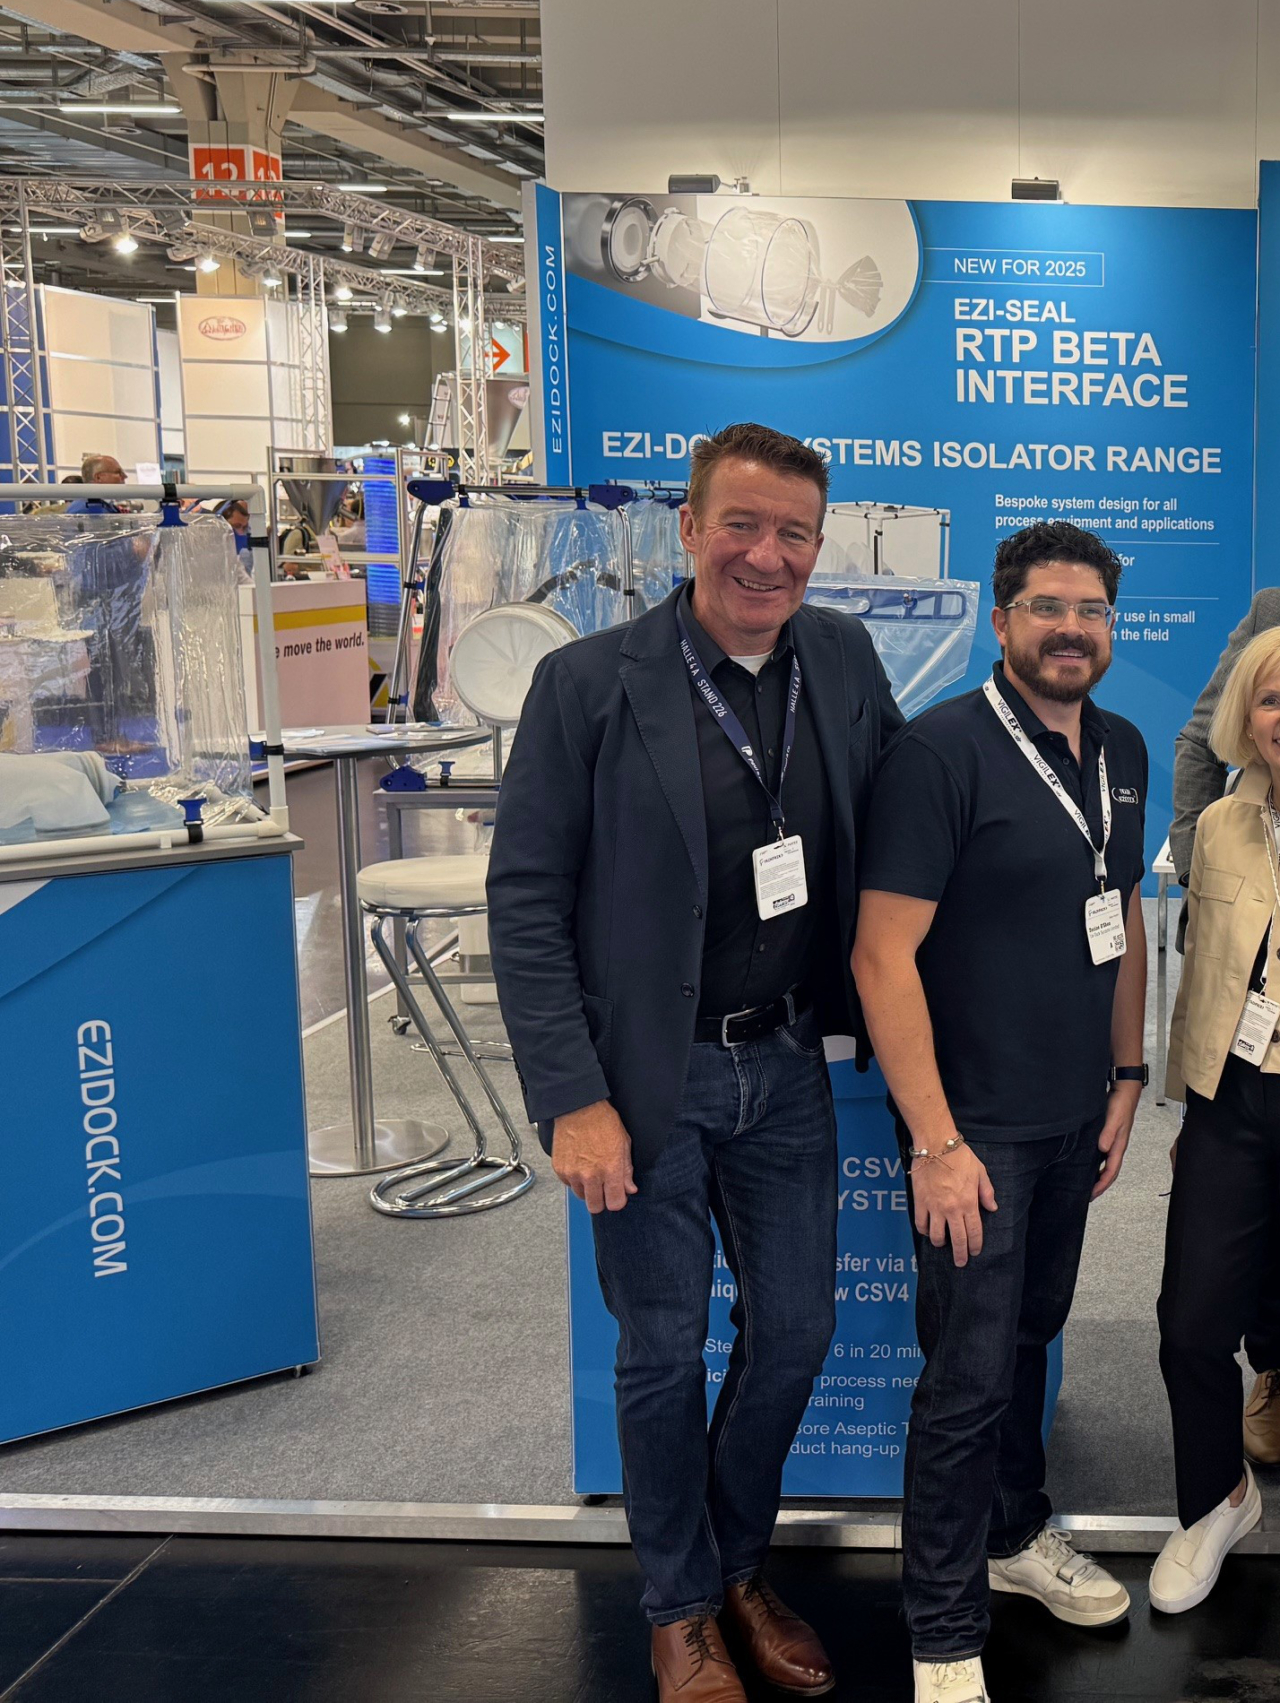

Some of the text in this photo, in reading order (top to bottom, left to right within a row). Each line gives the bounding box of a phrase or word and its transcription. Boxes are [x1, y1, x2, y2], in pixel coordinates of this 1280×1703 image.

[954, 257, 1086, 277] NEW FOR 2025
[954, 298, 1076, 323] EZI-SEAL
[545, 245, 562, 454] EZIDOCK.COM
[955, 327, 1163, 367] RTP BETA
[956, 368, 1189, 408] INTERFACE
[933, 441, 1097, 472] ISOLATOR
[1106, 445, 1222, 474] RANGE
[995, 494, 1177, 514] Bespoke system design for all
[1115, 515, 1138, 529] and
[1141, 517, 1214, 532] applications
[1124, 611, 1145, 623] use
[1149, 610, 1160, 623] in
[1163, 610, 1196, 623] small
[1121, 629, 1140, 641] the
[1143, 628, 1170, 641] field
[283, 641, 312, 658] move
[315, 637, 332, 652] the
[335, 632, 365, 650] world.
[680, 639, 694, 663] HALLE
[697, 679, 719, 704] STAND
[712, 702, 728, 718] 226
[77, 1018, 128, 1277] EZIDOCK.COM
[842, 1157, 903, 1178] CSV
[836, 1253, 871, 1272] sfer
[876, 1253, 905, 1272] via
[854, 1282, 910, 1303] CSV4
[833, 1343, 845, 1358] 6
[849, 1343, 864, 1358] in
[869, 1344, 891, 1359] 20
[820, 1374, 886, 1390] process
[808, 1394, 865, 1411] raining
[834, 1421, 897, 1438] Aseptic
[790, 1440, 900, 1458] duct hang-up
